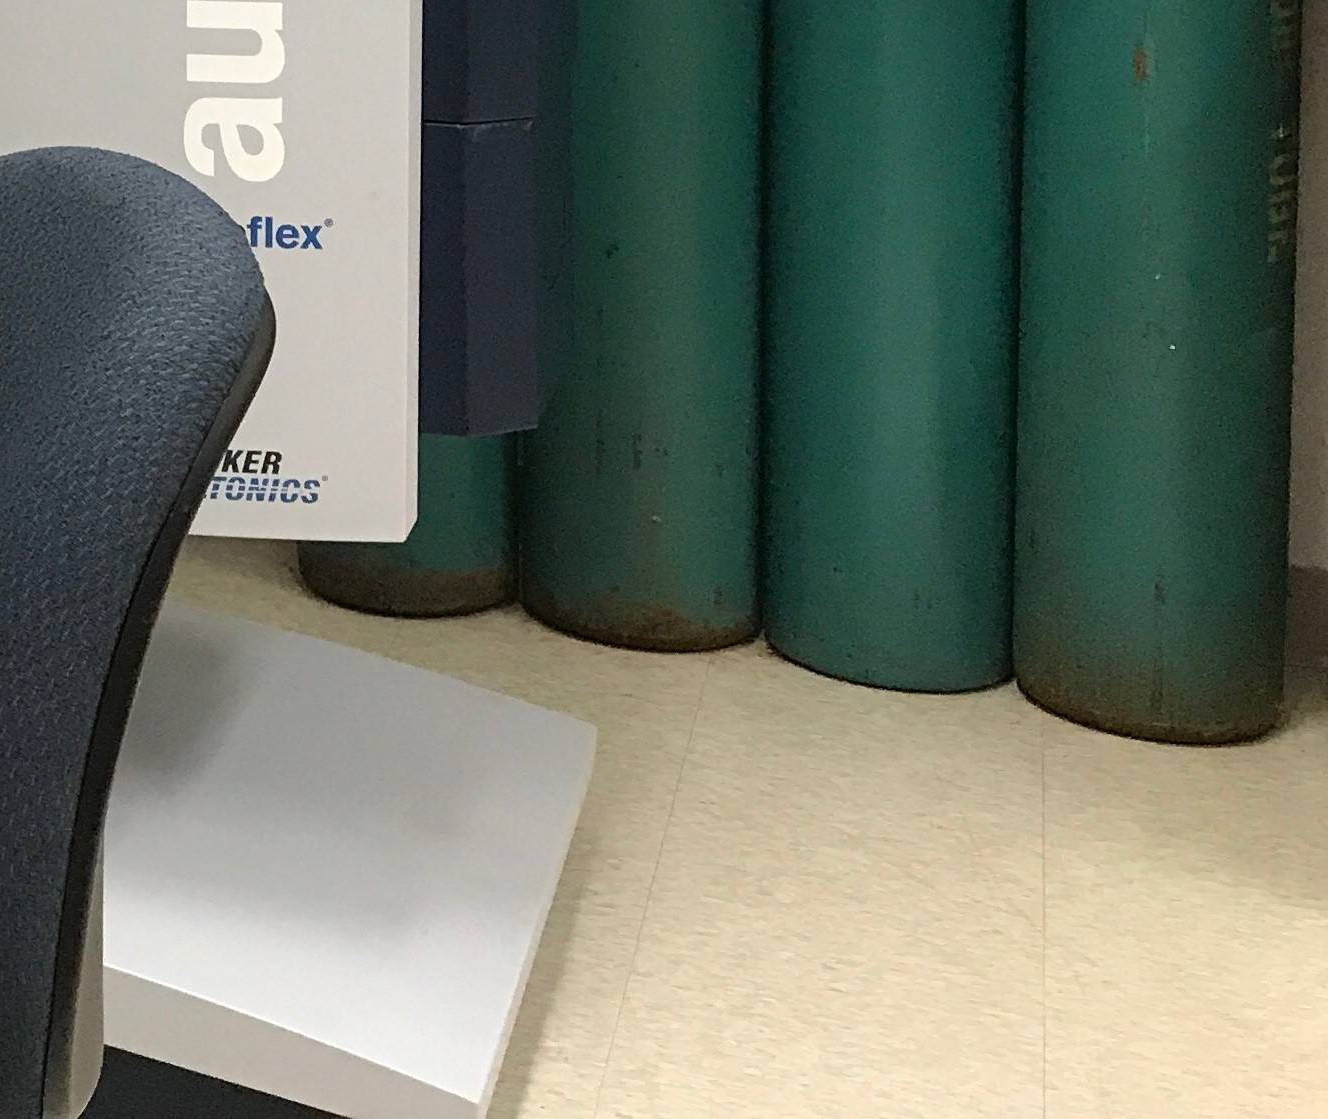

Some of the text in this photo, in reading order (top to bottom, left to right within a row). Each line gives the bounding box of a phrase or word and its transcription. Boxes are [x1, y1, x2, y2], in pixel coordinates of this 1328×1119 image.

[249, 216, 323, 250] flex
[219, 450, 282, 475] KER
[207, 477, 321, 503] TONICS
